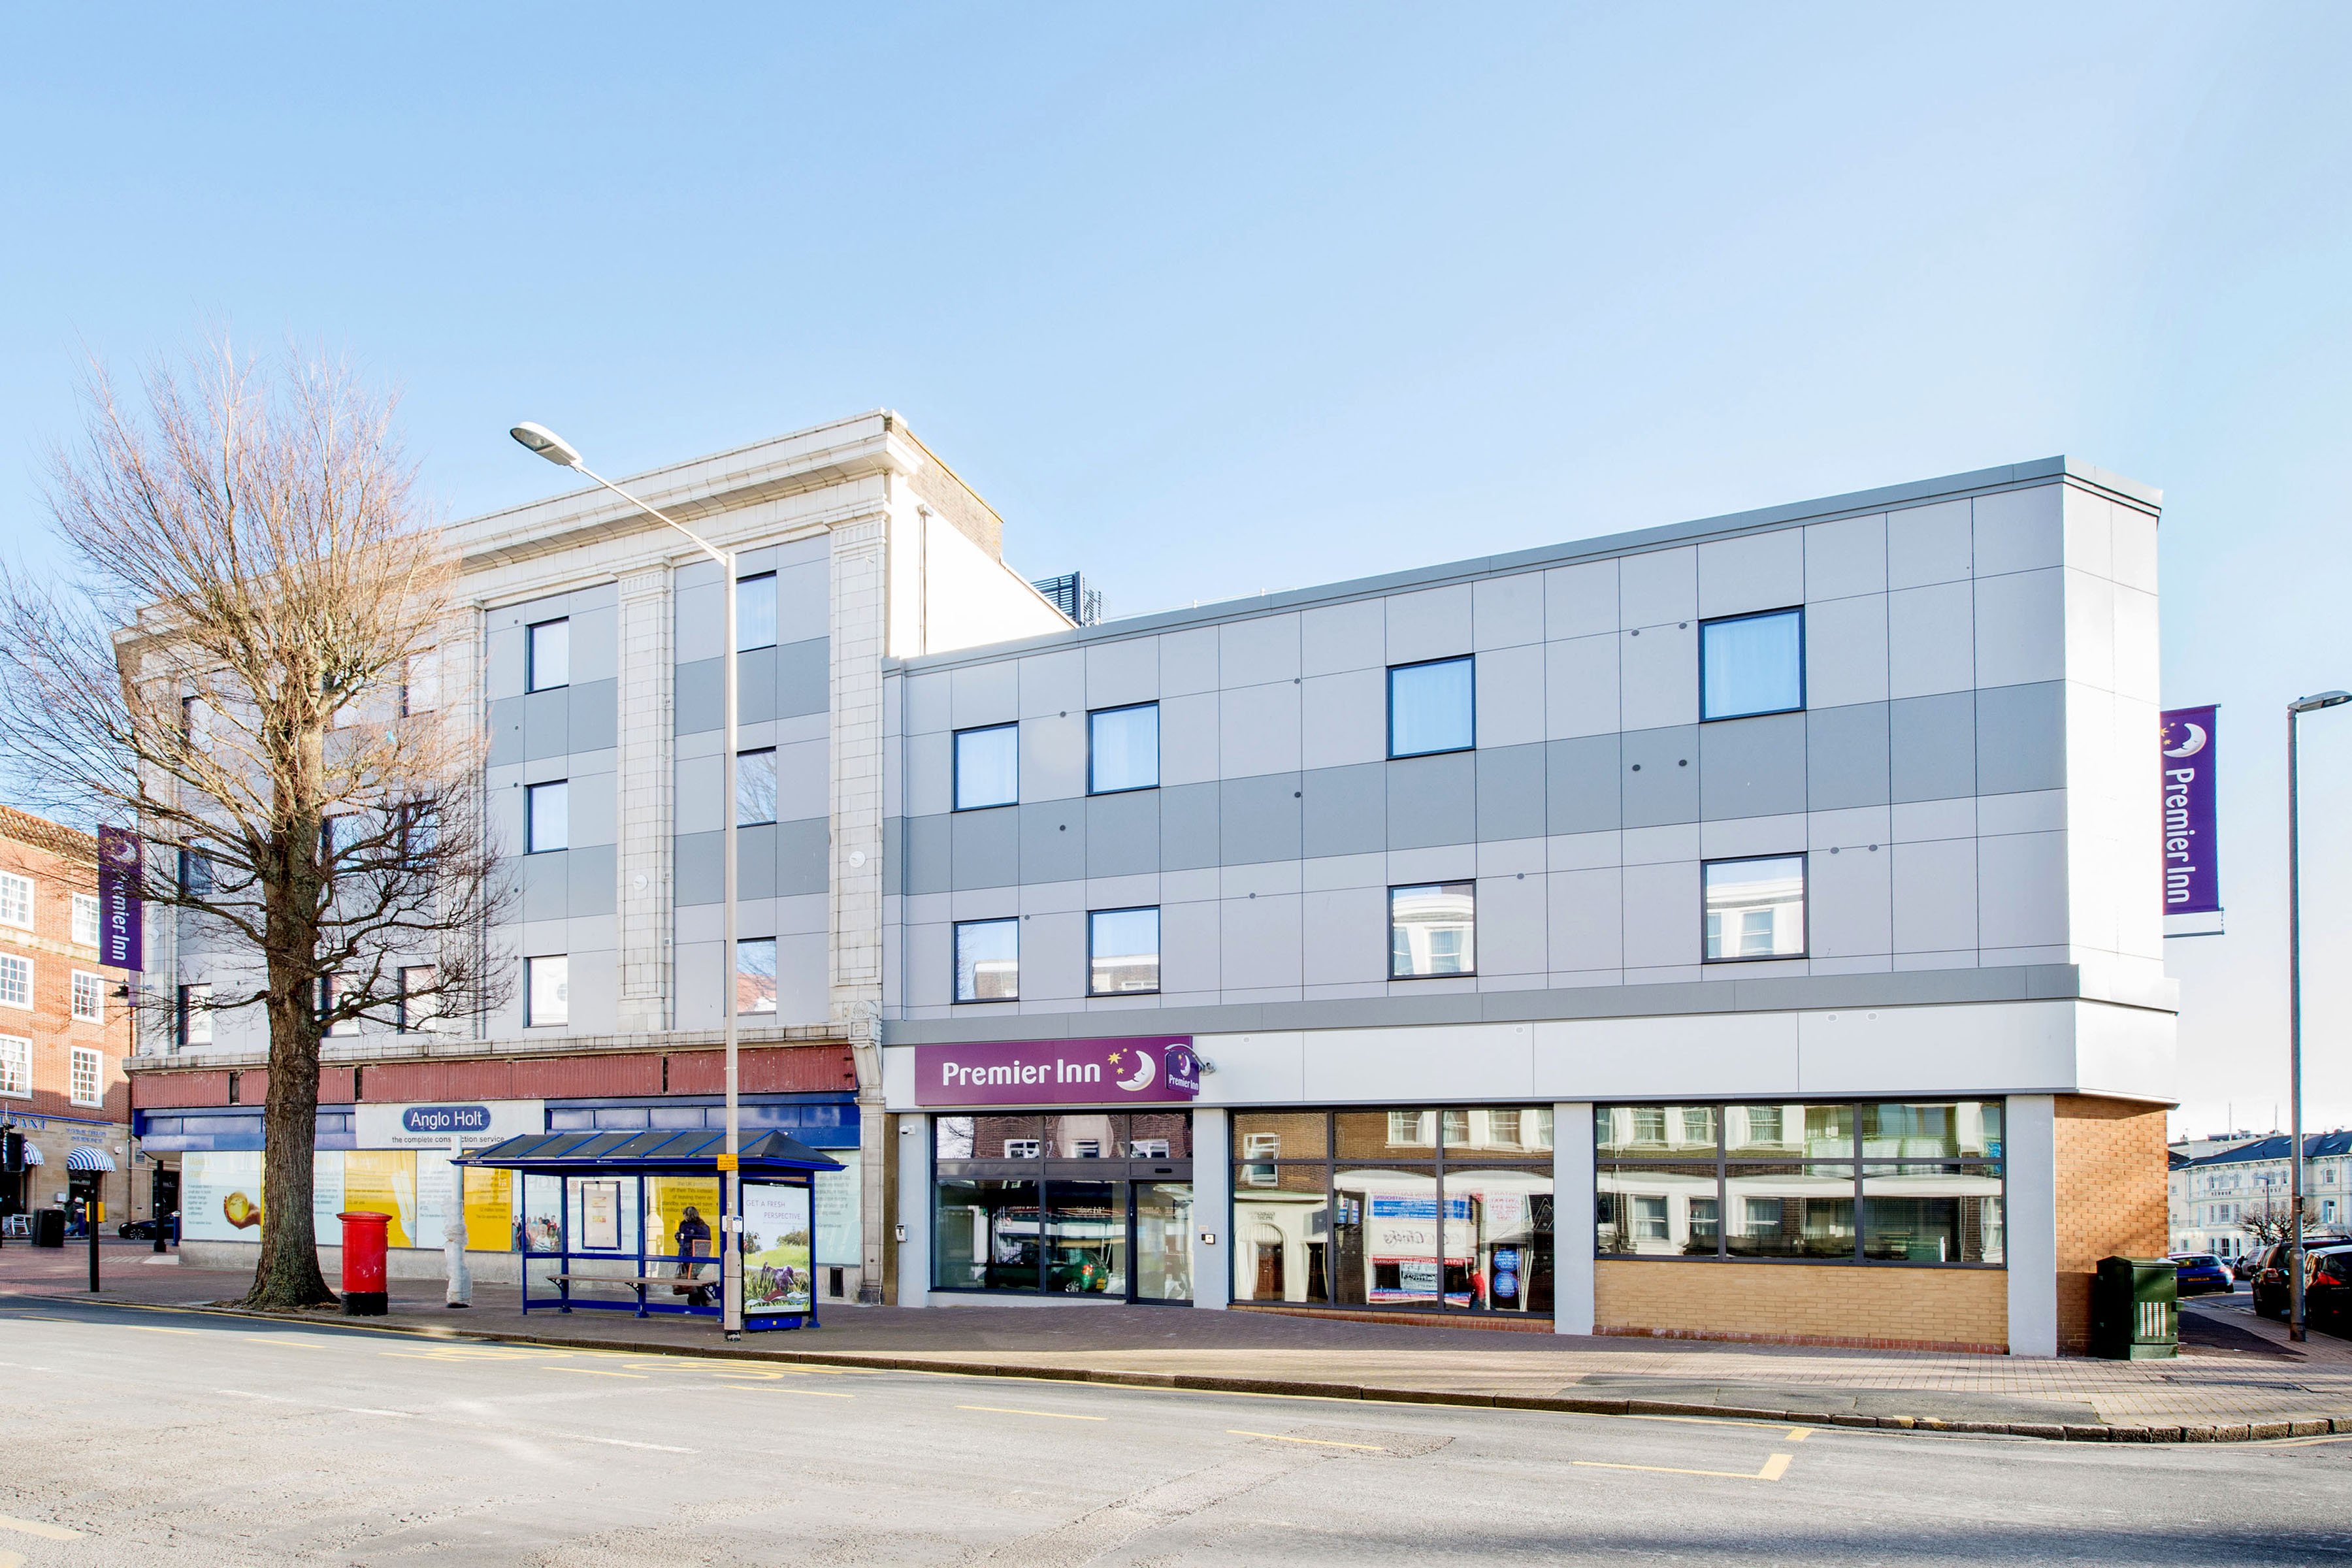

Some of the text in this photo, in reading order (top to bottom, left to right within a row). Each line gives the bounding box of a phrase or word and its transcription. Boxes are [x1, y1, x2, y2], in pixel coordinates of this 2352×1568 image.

[2164, 768, 2196, 904] Premier Inn
[112, 935, 130, 960] Inn
[943, 1059, 1100, 1086] Premier Inn
[1169, 1073, 1199, 1090] Premier Inn
[411, 1111, 482, 1130] Anglo Holt
